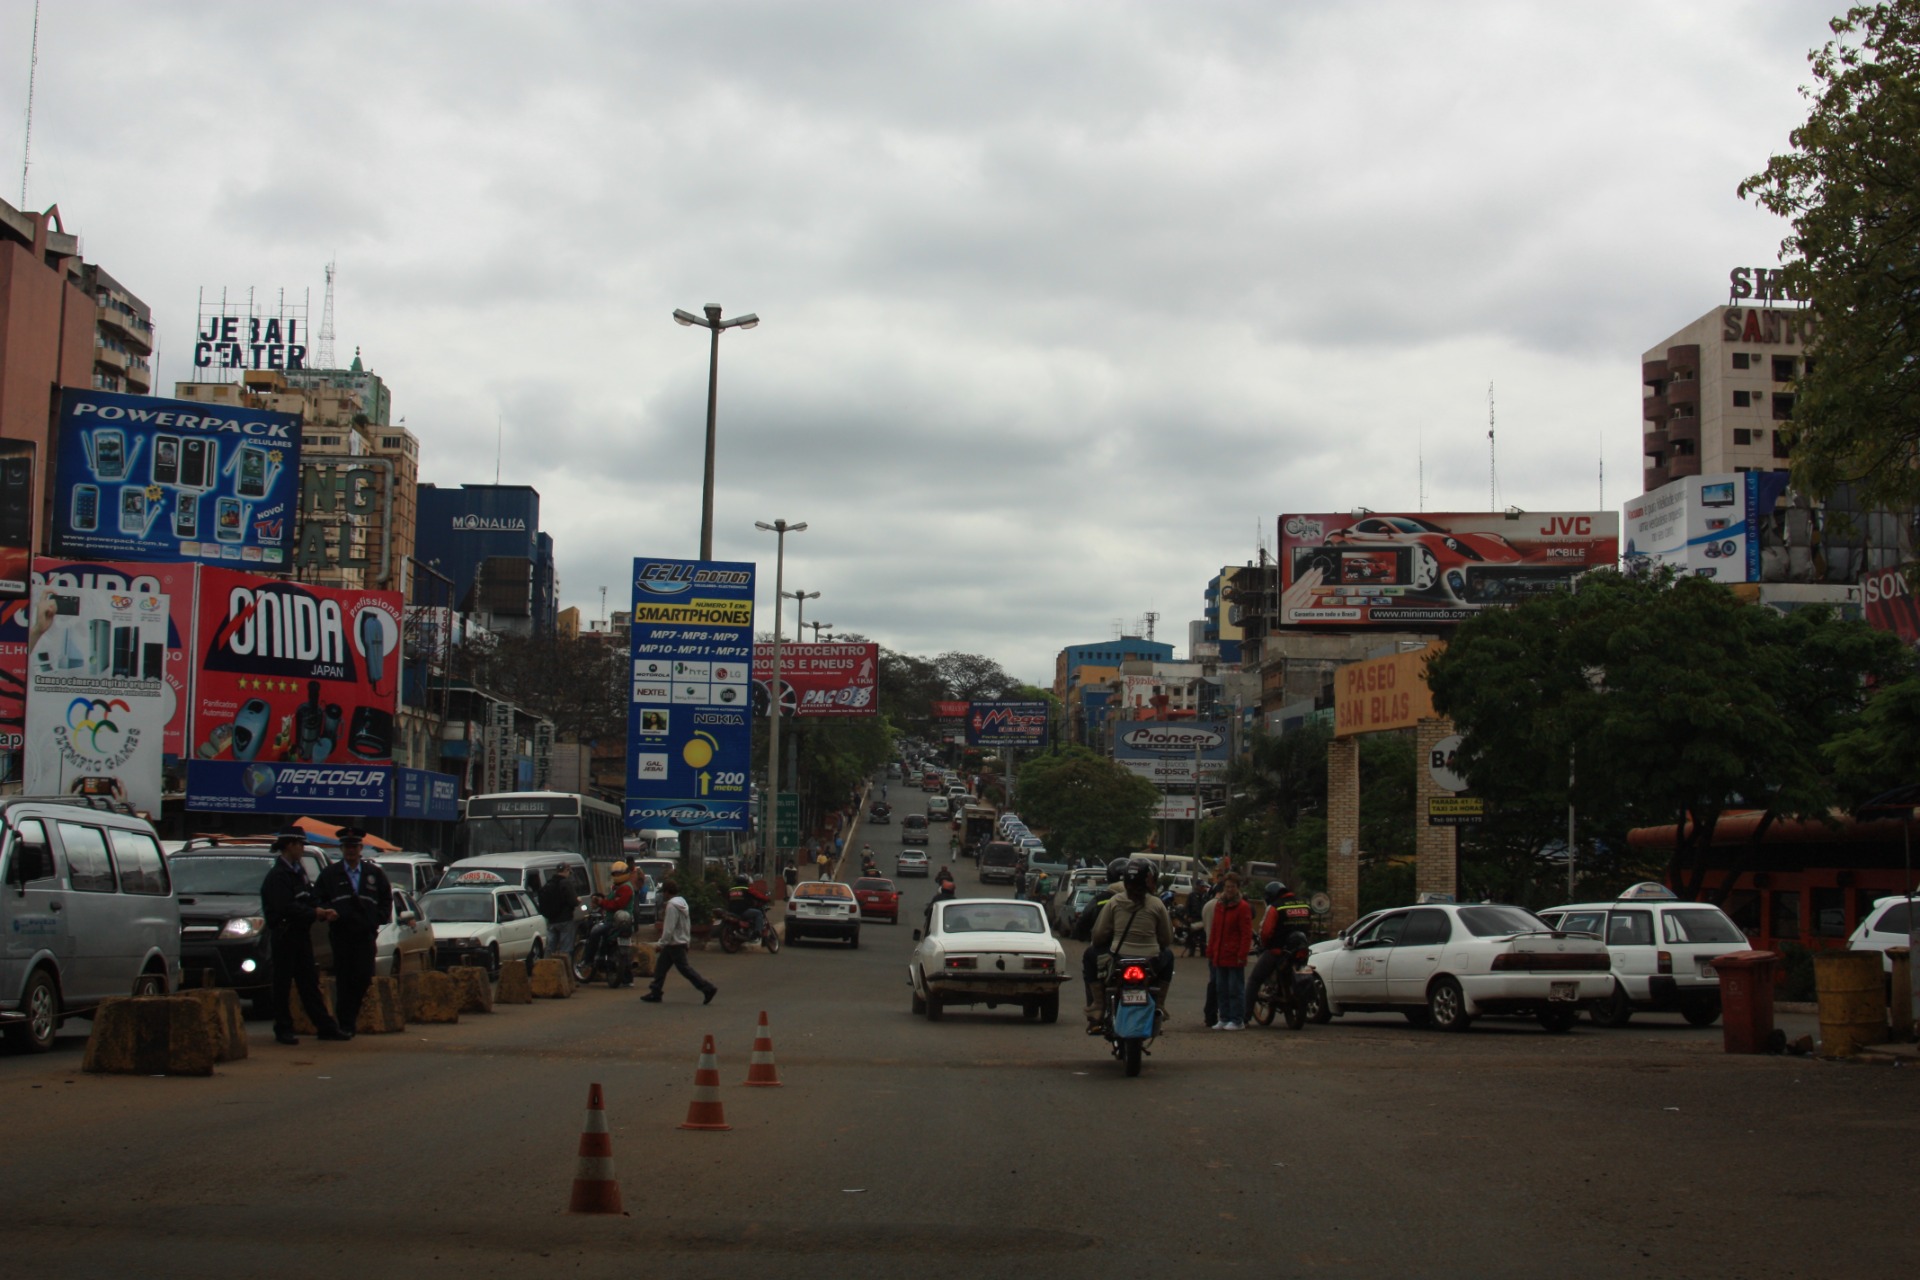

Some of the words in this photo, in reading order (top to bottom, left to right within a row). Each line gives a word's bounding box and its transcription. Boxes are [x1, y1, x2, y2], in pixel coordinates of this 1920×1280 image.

[200, 317, 296, 343] JEBAI
[195, 343, 306, 370] CENTER
[73, 403, 289, 438] POWERPACK
[248, 438, 292, 448] CELULARES
[257, 503, 284, 520] NOVO!
[254, 517, 284, 537] TV
[452, 514, 525, 529] MONALISA
[1541, 516, 1591, 536] JVC
[62, 534, 169, 547] www.powerpack.com.tw
[1547, 548, 1585, 557] MOBILE
[350, 597, 402, 622] Profissional
[638, 607, 751, 624] SMARTPHONES
[229, 587, 344, 663] ONIDA
[780, 646, 867, 657] AUTOCENTRO
[311, 664, 344, 679] JAPAN
[799, 659, 808, 669] E
[811, 659, 854, 669] PNEUS
[730, 670, 741, 678] LG
[1348, 663, 1396, 695] PASEO
[637, 687, 668, 697] NEXTEL
[1340, 699, 1363, 727] SAN
[1371, 692, 1409, 724] BLAS
[694, 713, 745, 725] NOKIA
[1132, 729, 1214, 744] Pioneer
[276, 768, 386, 787] MERCOSUR
[715, 772, 745, 785] 200
[276, 785, 384, 798] CAMBIOS
[714, 783, 744, 793] metros
[629, 809, 742, 820] POWERPACK
